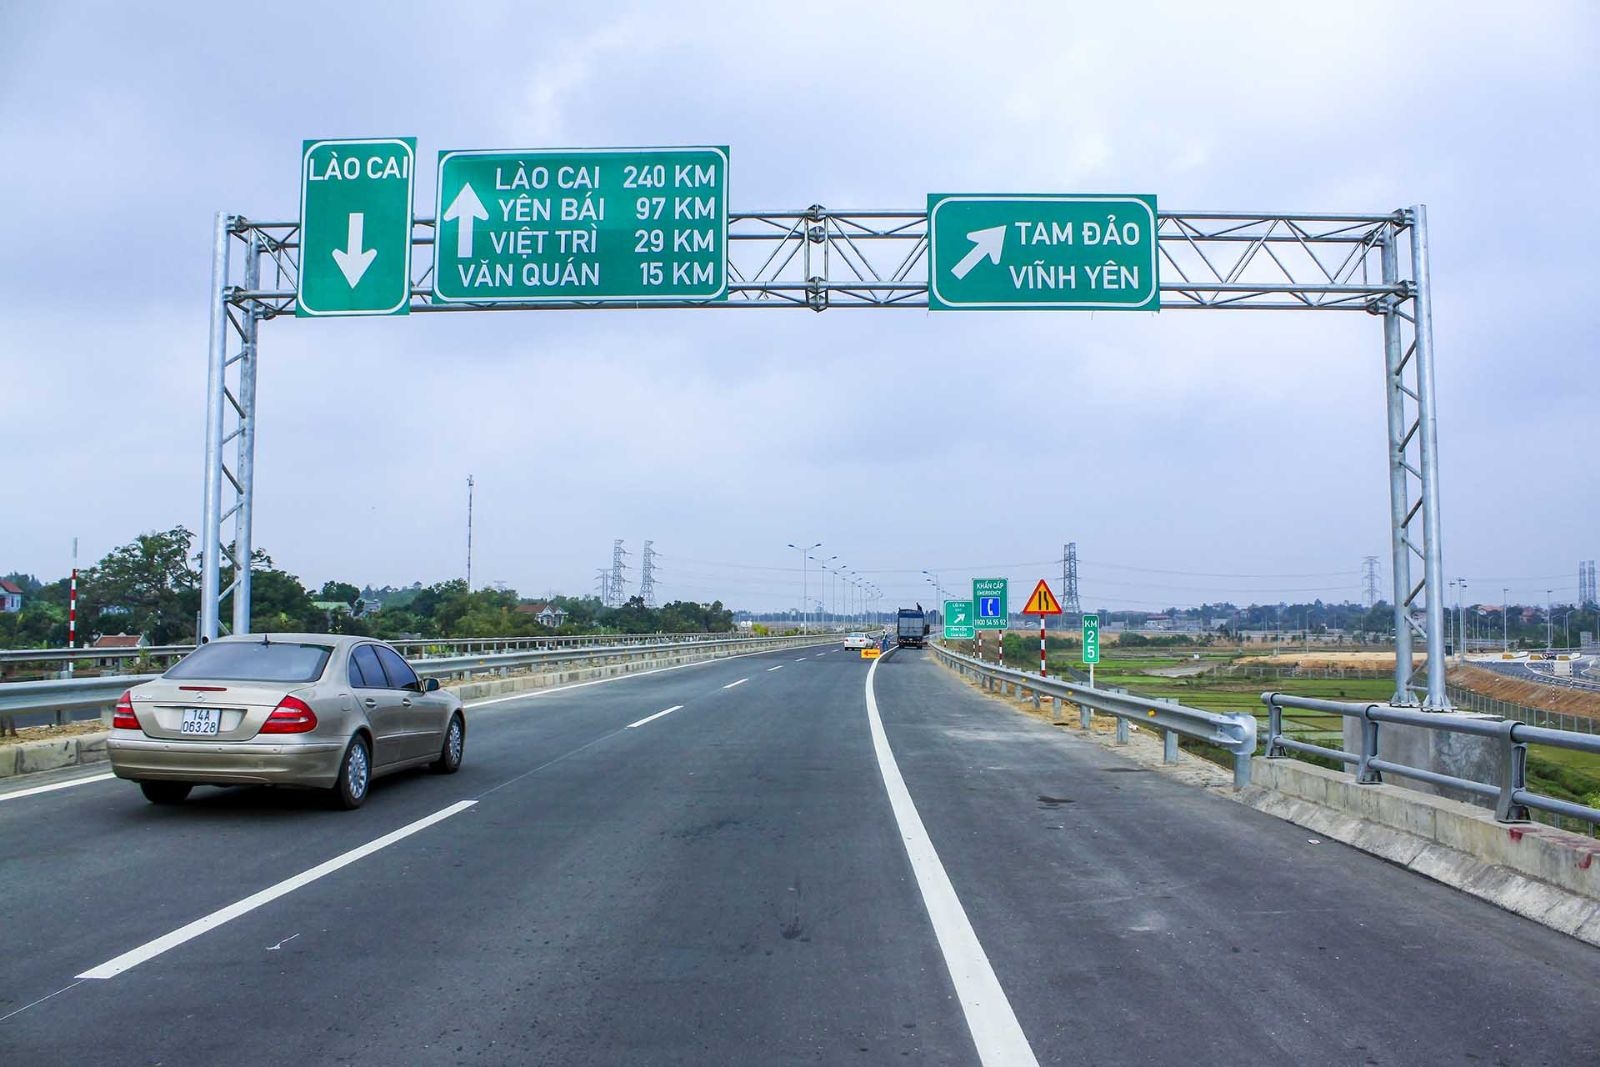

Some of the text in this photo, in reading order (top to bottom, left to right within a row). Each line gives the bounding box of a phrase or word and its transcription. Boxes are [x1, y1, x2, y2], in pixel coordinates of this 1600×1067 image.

[309, 152, 408, 181] LÀO CAI
[496, 161, 715, 190] LÀO CAI 240 KM
[499, 192, 715, 222] YÊN BÁI 97 KM
[489, 224, 714, 259] VIỆT TRÌ 29 KM
[1015, 214, 1140, 245] TAM ĐẢO
[458, 257, 714, 288] VĂN QUÁN 15 KM
[1009, 260, 1139, 289] VĨNH YÊN
[1084, 620, 1098, 628] KM
[182, 721, 217, 733] 063.28
[192, 709, 210, 721] 14A
